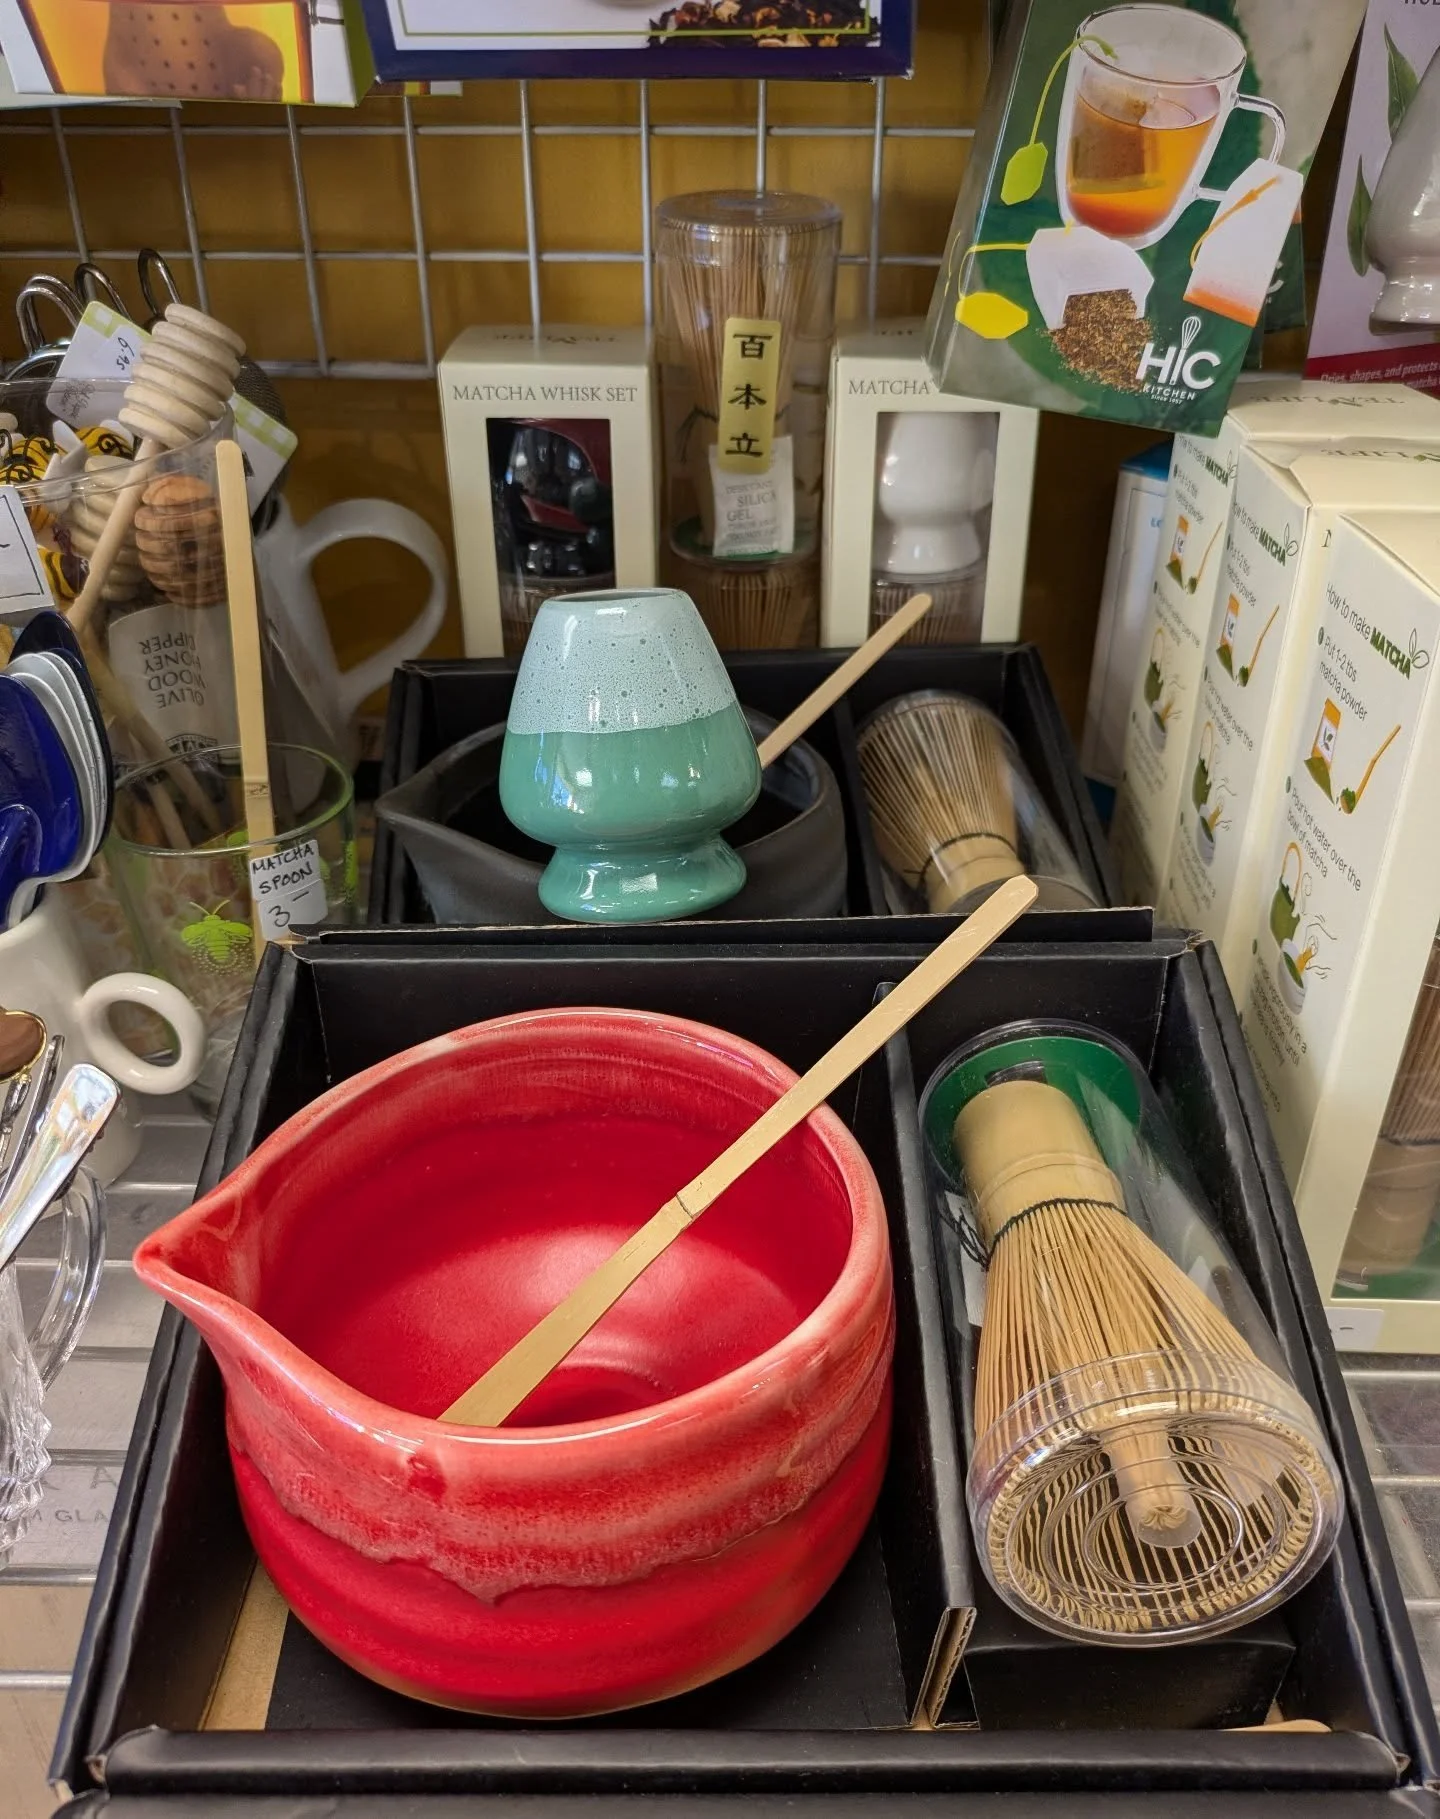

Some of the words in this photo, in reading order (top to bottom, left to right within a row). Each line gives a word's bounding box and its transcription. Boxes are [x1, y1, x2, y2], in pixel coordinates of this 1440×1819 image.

[1135, 316, 1221, 390] HIC
[848, 379, 930, 395] MATCHA
[1384, 363, 1403, 378] and
[453, 385, 537, 401] MATCHA
[540, 386, 601, 401] WHISK
[605, 387, 637, 402] SET
[725, 333, 773, 458] 百本立
[1142, 383, 1196, 400] KITCHEN
[1205, 455, 1229, 488] MATCHA
[726, 509, 753, 521] GEL
[1258, 527, 1286, 567] MATCHA
[1326, 581, 1342, 611] How
[1340, 598, 1350, 619] to
[1349, 609, 1371, 641] make
[1370, 626, 1412, 680] MATCHA
[1324, 636, 1335, 660] Put
[1335, 647, 1347, 671] 1-2
[1346, 658, 1357, 683] tbs
[148, 669, 208, 692] WOOD
[1320, 661, 1342, 694] matcha
[1340, 684, 1368, 722] powder
[155, 687, 205, 709] OLIVE
[252, 844, 315, 874] MATCHA
[1304, 839, 1328, 878] matcha
[1312, 823, 1331, 853] water
[1330, 849, 1348, 874] over
[1347, 864, 1362, 892] the
[259, 861, 313, 895] SPOON
